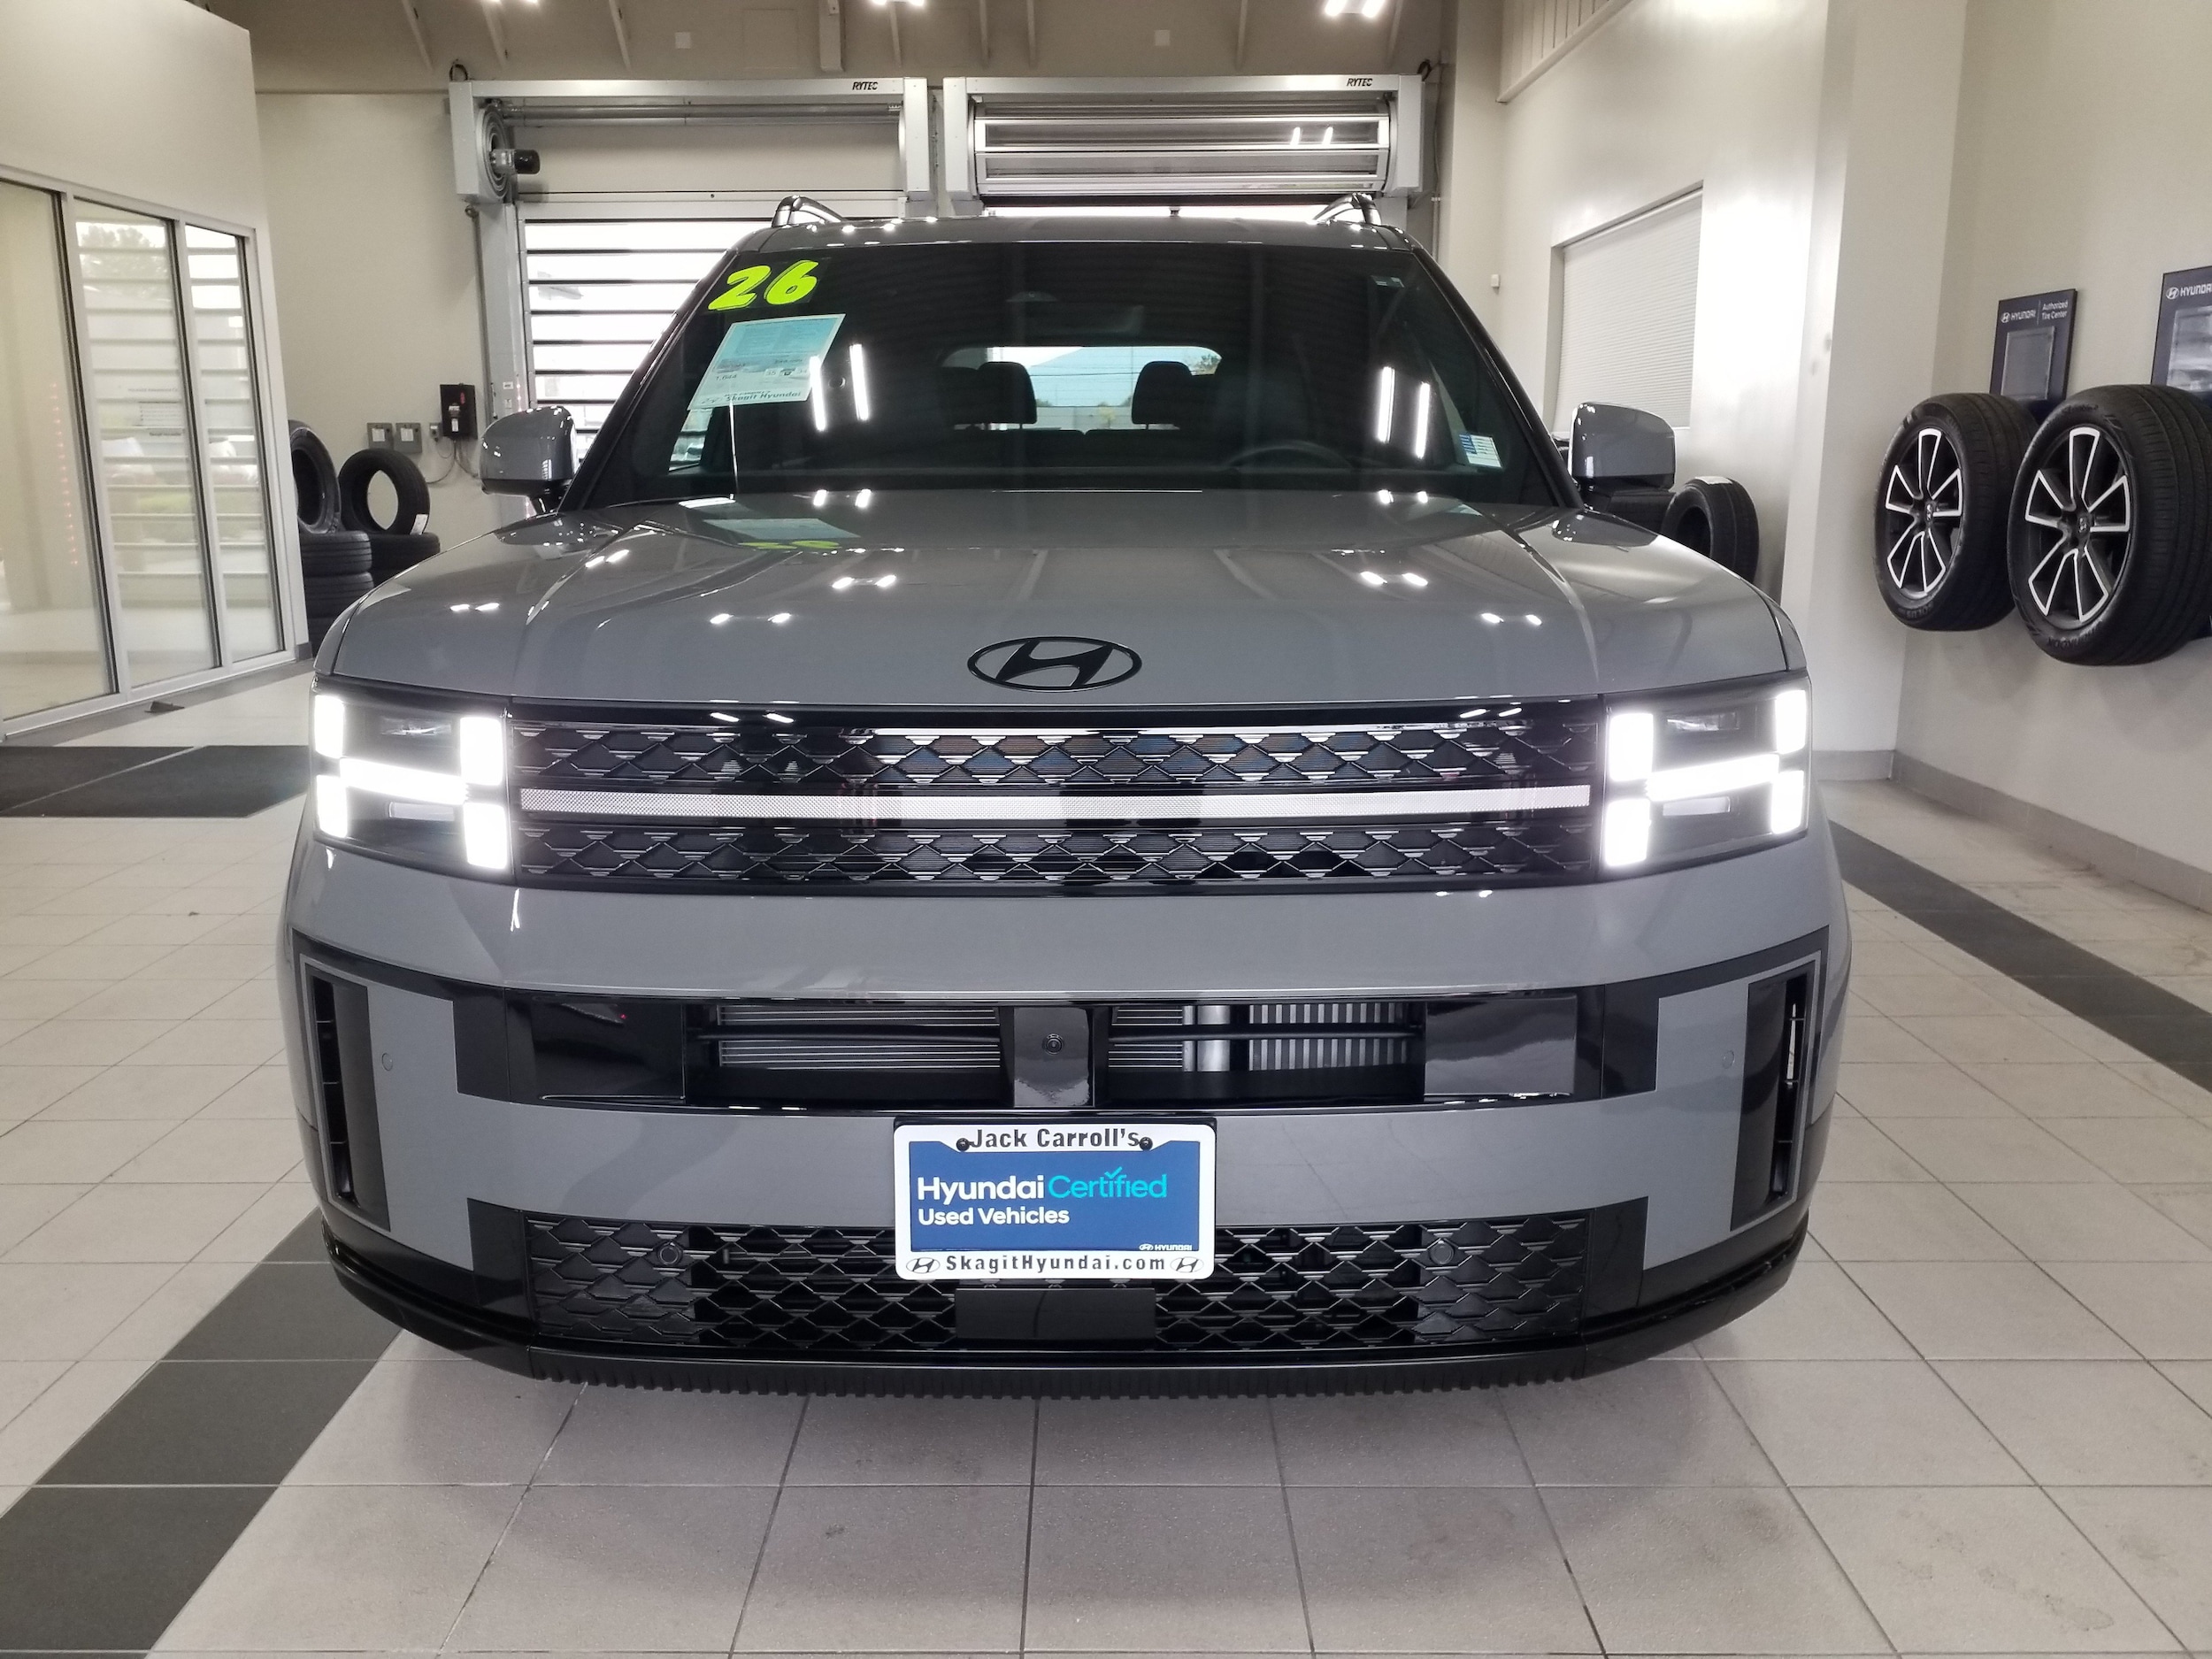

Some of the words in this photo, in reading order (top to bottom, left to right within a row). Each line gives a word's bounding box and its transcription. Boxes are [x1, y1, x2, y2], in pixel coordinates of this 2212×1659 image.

[852, 81, 878, 90] RYTEC
[1347, 78, 1373, 87] RYTEC
[708, 259, 819, 311] 26
[2180, 283, 2212, 296] HYUNDA
[2010, 310, 2036, 320] HYUNDAI
[972, 1129, 1027, 1148] Jack
[1036, 1128, 1140, 1148] Carroll's
[917, 1174, 1045, 1205] Hyundai
[1048, 1166, 1168, 1199] Certified
[918, 1208, 974, 1225] Used
[978, 1206, 1071, 1225] Vehicles
[946, 1255, 1166, 1274] SkagitHyundai.com
